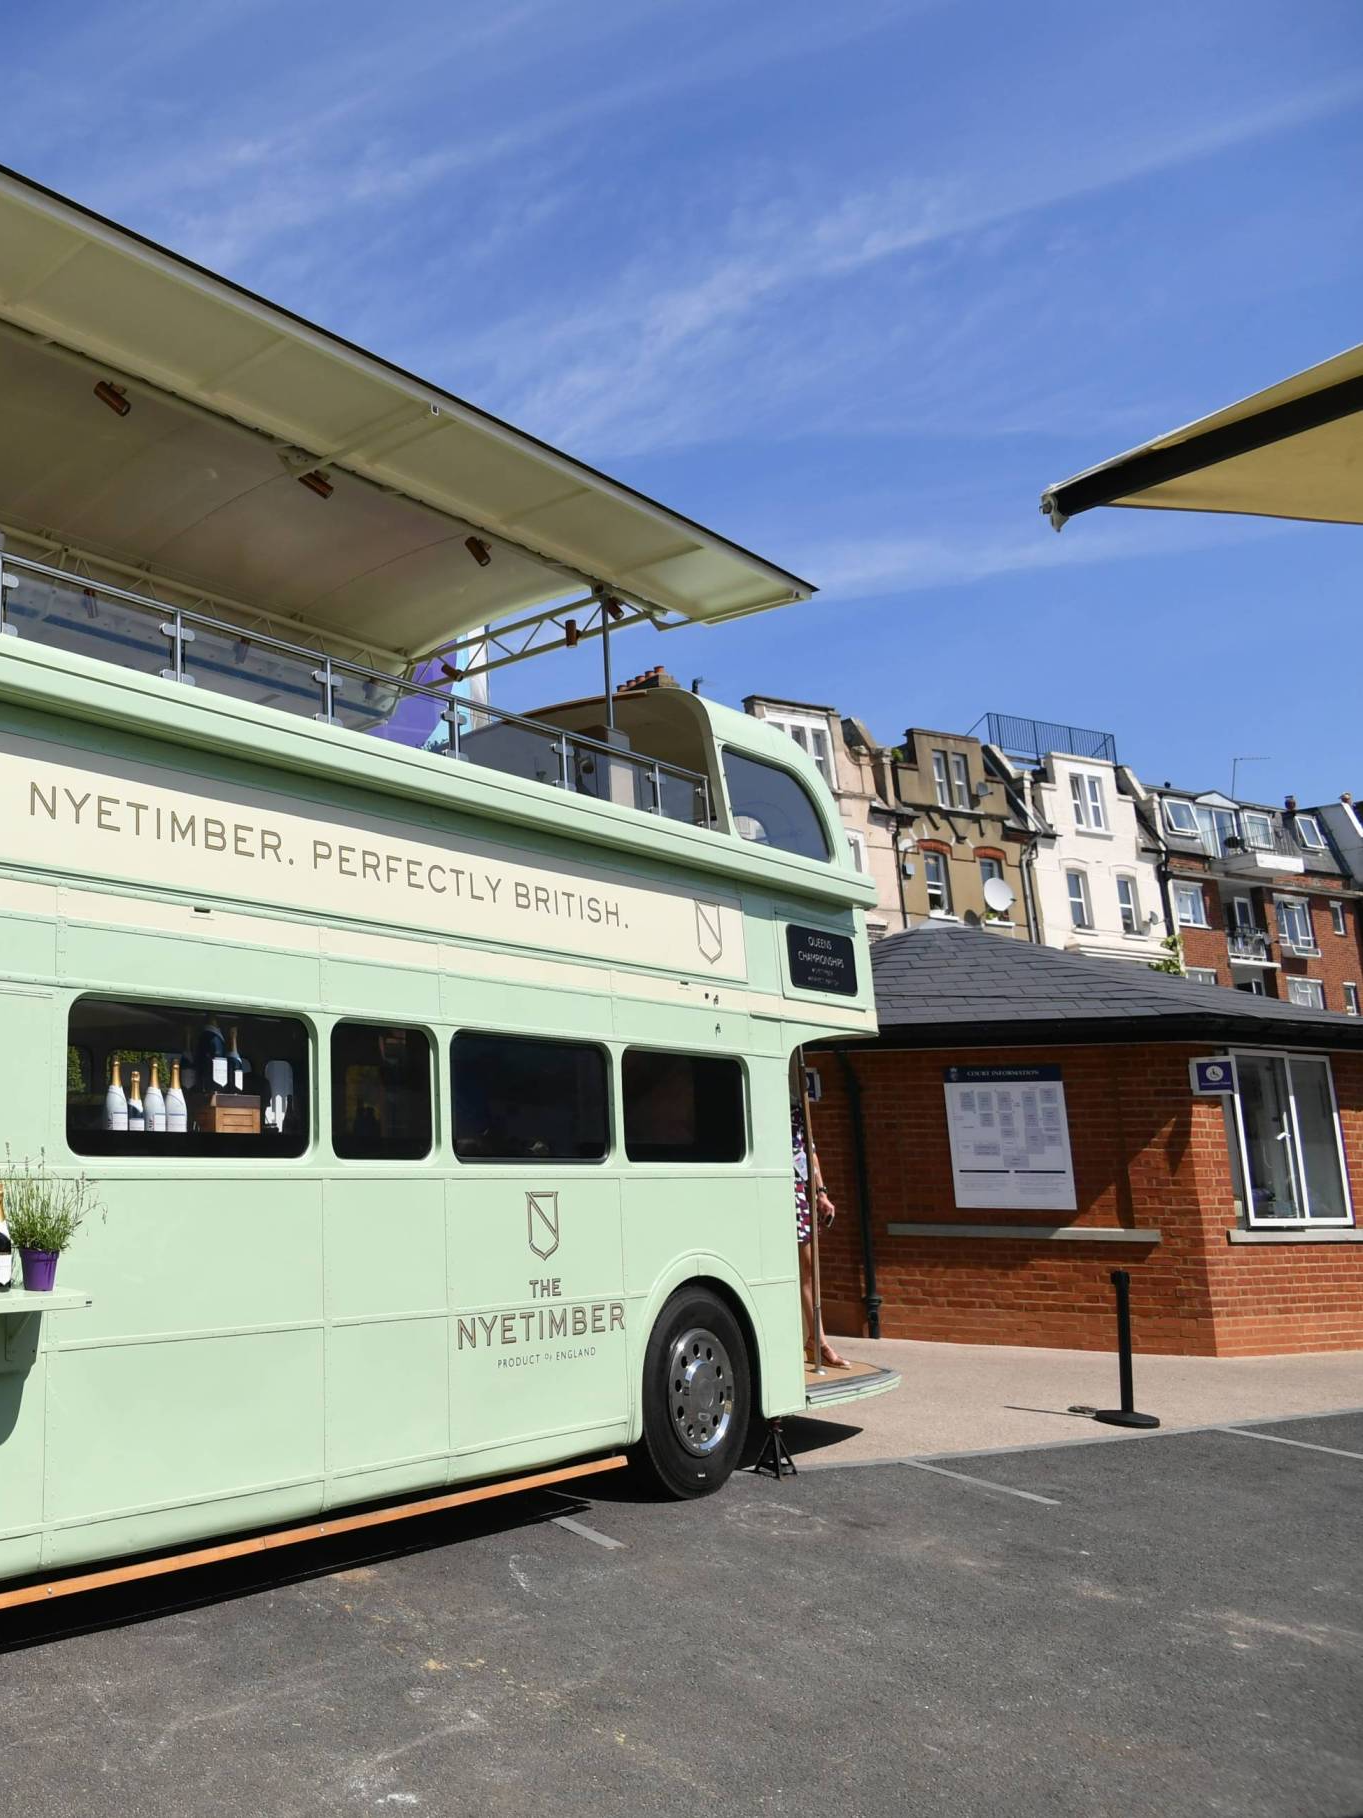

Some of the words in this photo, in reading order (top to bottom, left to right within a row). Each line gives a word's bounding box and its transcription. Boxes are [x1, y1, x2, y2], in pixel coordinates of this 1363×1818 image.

[29, 780, 295, 866] NYETIMBER.
[312, 839, 503, 904] PERFECTLY
[513, 880, 629, 931] BRITISH.
[807, 936, 833, 950] QUEENS
[797, 950, 844, 969] CHAMPIONSHIPS
[529, 1278, 562, 1298] THE
[457, 1302, 626, 1350] NYETIMBER
[497, 1354, 541, 1369] PRODUCT
[555, 1346, 596, 1361] ENGLAND
